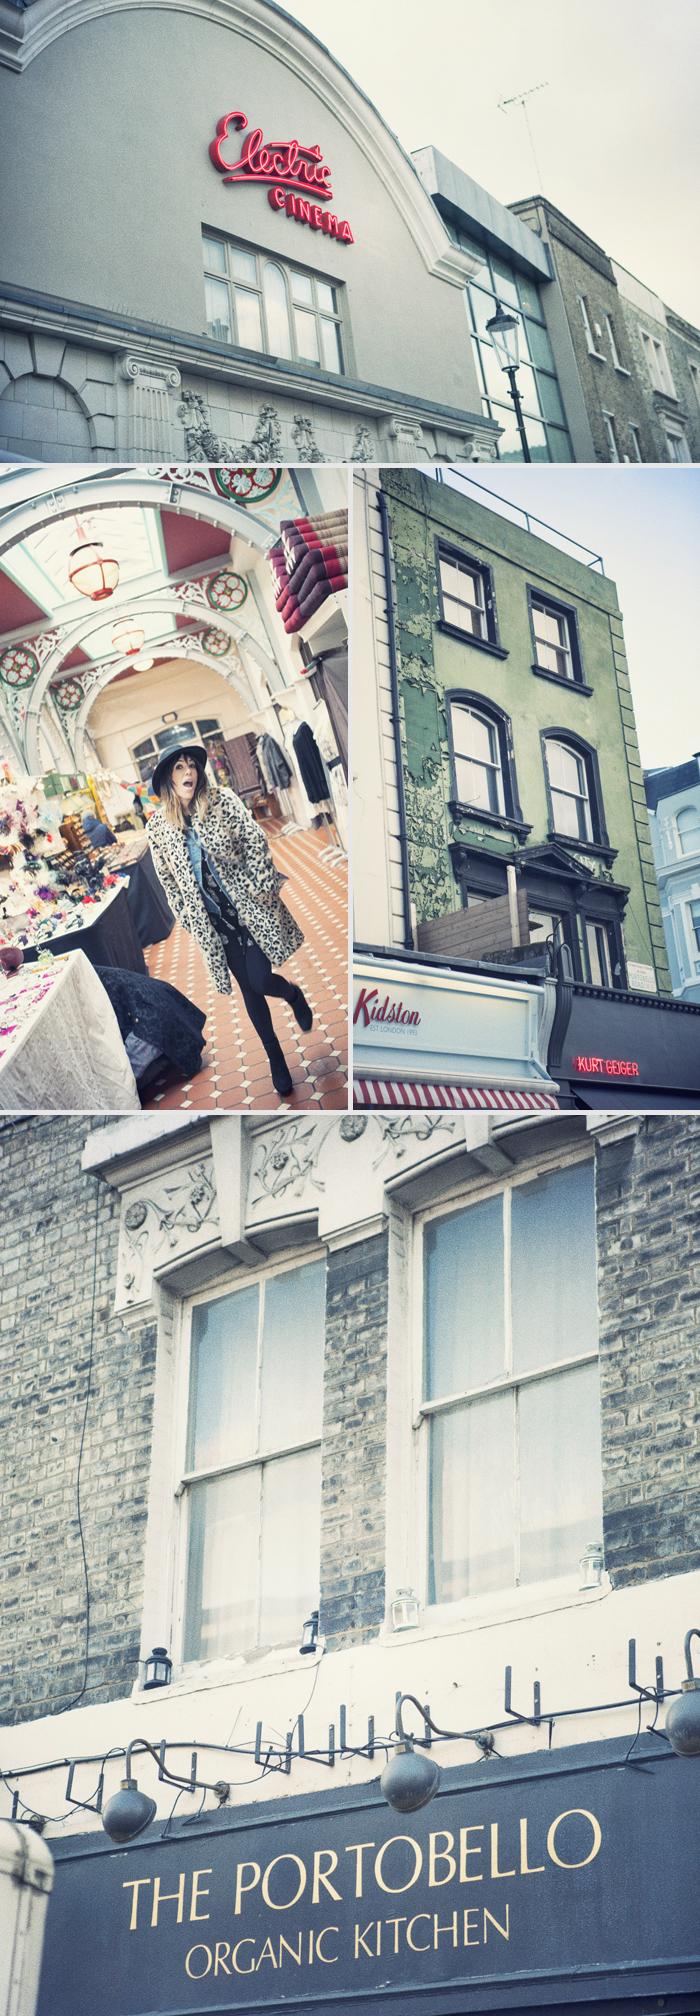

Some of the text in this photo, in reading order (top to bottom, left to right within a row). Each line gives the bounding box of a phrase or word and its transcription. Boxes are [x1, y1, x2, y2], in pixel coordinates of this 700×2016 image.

[208, 111, 332, 189] Electric
[268, 186, 354, 245] CINEMA
[353, 988, 421, 1027] Kidston
[577, 1056, 640, 1076] KURT GEIGER
[122, 1808, 602, 1931] THE PORTOBELLO
[185, 1903, 511, 1979] ORGANIC KITCHEN
